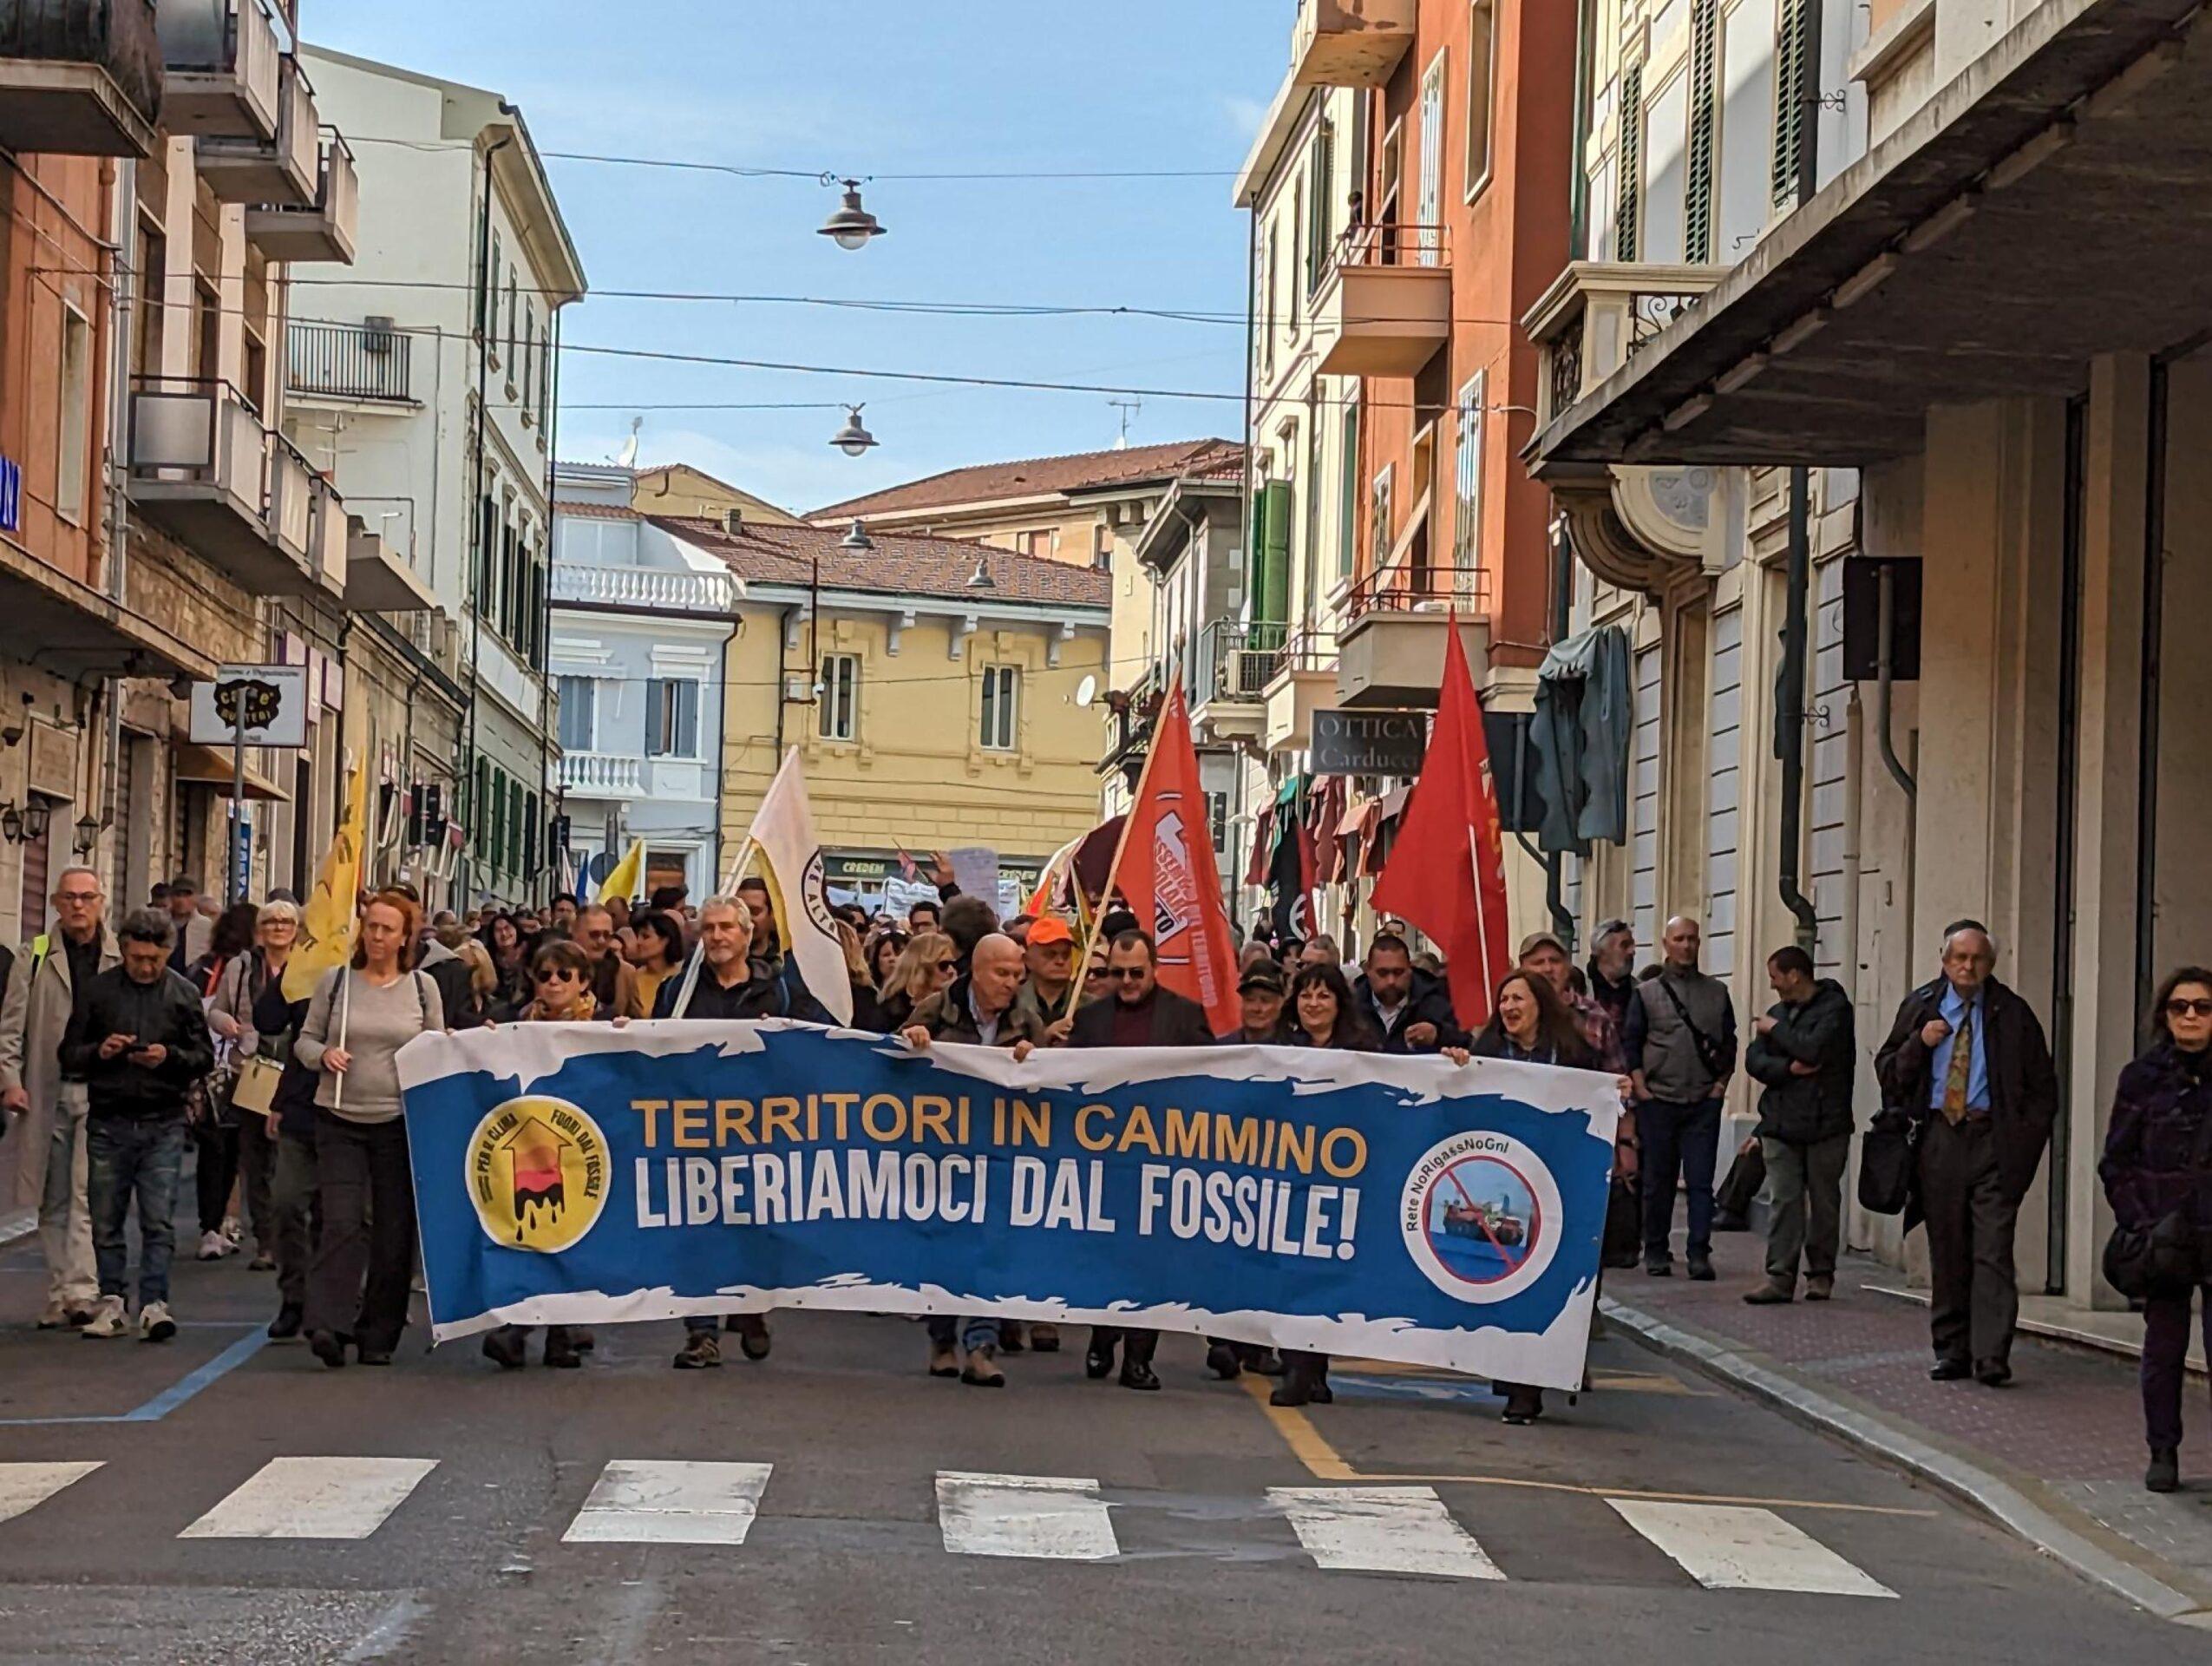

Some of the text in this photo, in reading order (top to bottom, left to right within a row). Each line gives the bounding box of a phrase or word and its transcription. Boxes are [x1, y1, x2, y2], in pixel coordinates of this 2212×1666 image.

[1319, 716, 1418, 738] OTTICA
[1319, 747, 1418, 769] Carducci
[550, 1109, 582, 1136] FUORI
[577, 1131, 596, 1154] DAL
[631, 1093, 1368, 1177] TERRITORI IN CAMMINO
[635, 1149, 1360, 1261] LIBERIAMOCI DAL FOSSILE!
[1405, 1197, 1420, 1231] Rete
